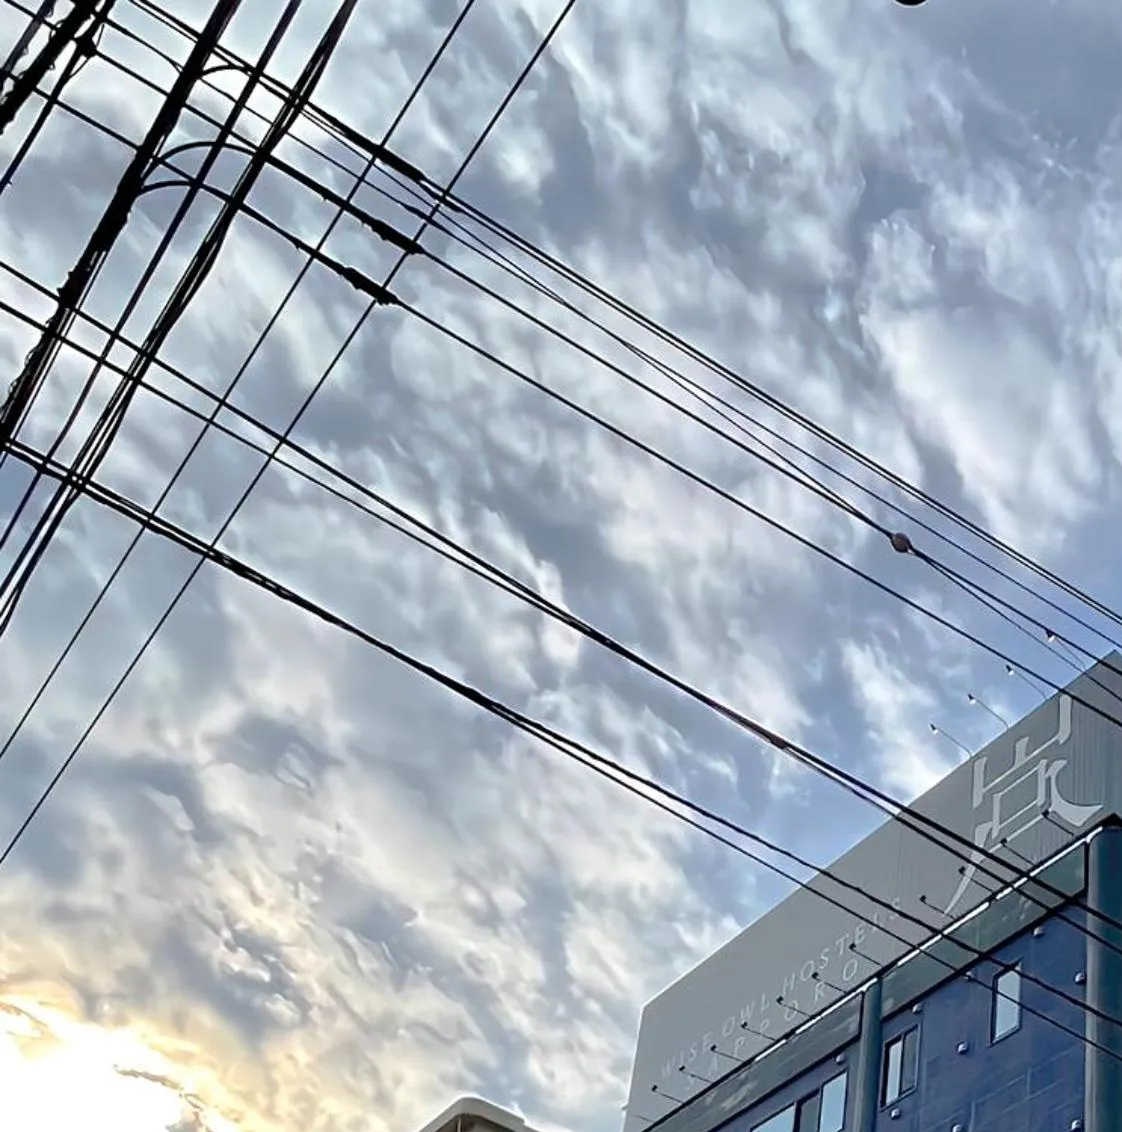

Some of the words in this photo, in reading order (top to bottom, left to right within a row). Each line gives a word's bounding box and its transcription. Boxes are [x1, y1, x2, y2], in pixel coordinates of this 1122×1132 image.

[662, 1035, 715, 1077] WISE
[722, 994, 768, 1036] OWL
[783, 898, 901, 997] HOSTELS
[688, 959, 858, 1083] SAPPORO
